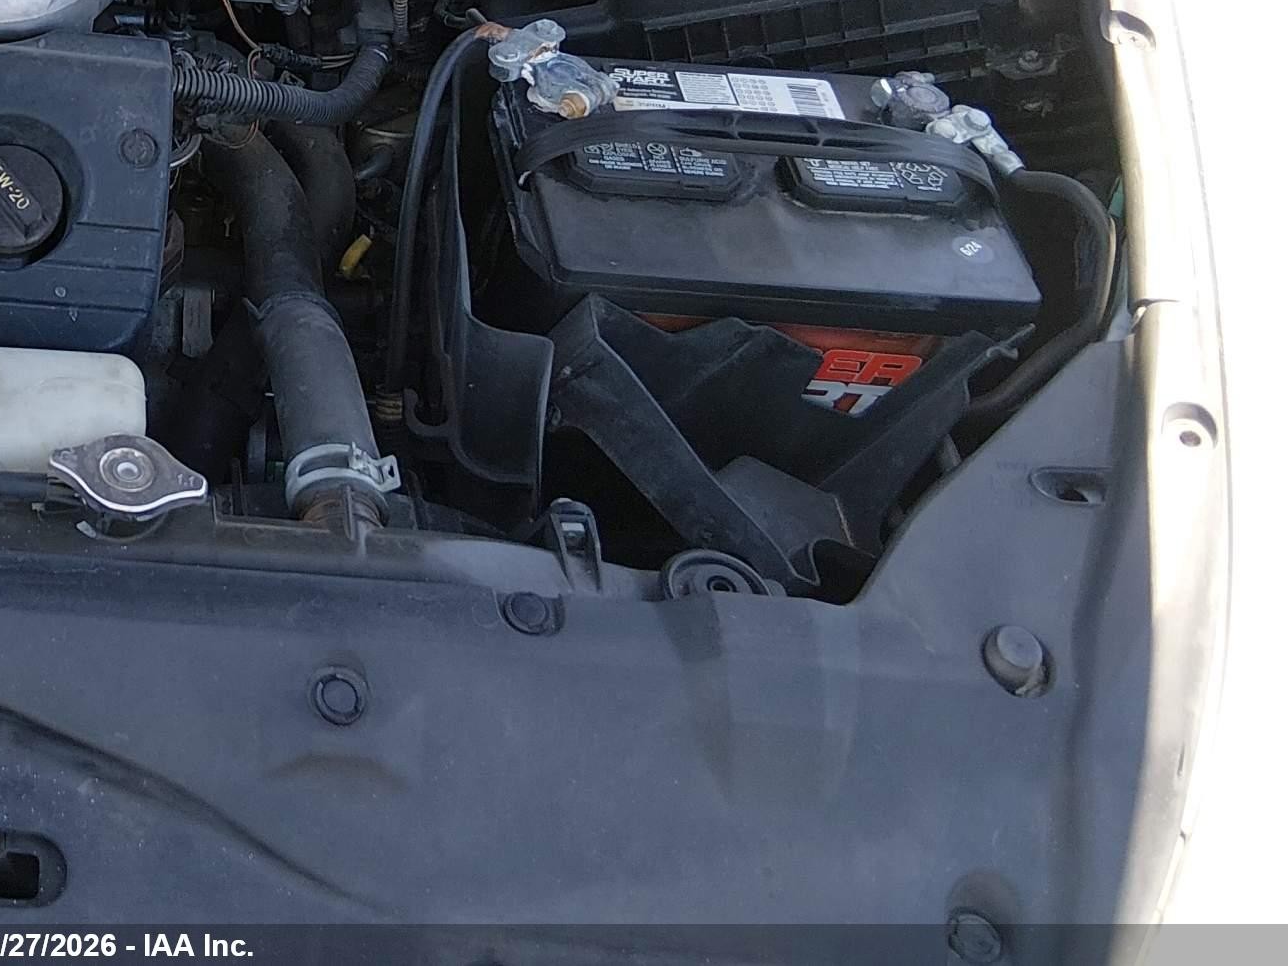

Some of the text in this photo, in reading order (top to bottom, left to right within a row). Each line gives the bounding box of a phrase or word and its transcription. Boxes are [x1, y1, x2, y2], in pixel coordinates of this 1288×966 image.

[609, 73, 672, 85] START
[613, 68, 669, 80] SUPER
[177, 473, 195, 487] 1.1
